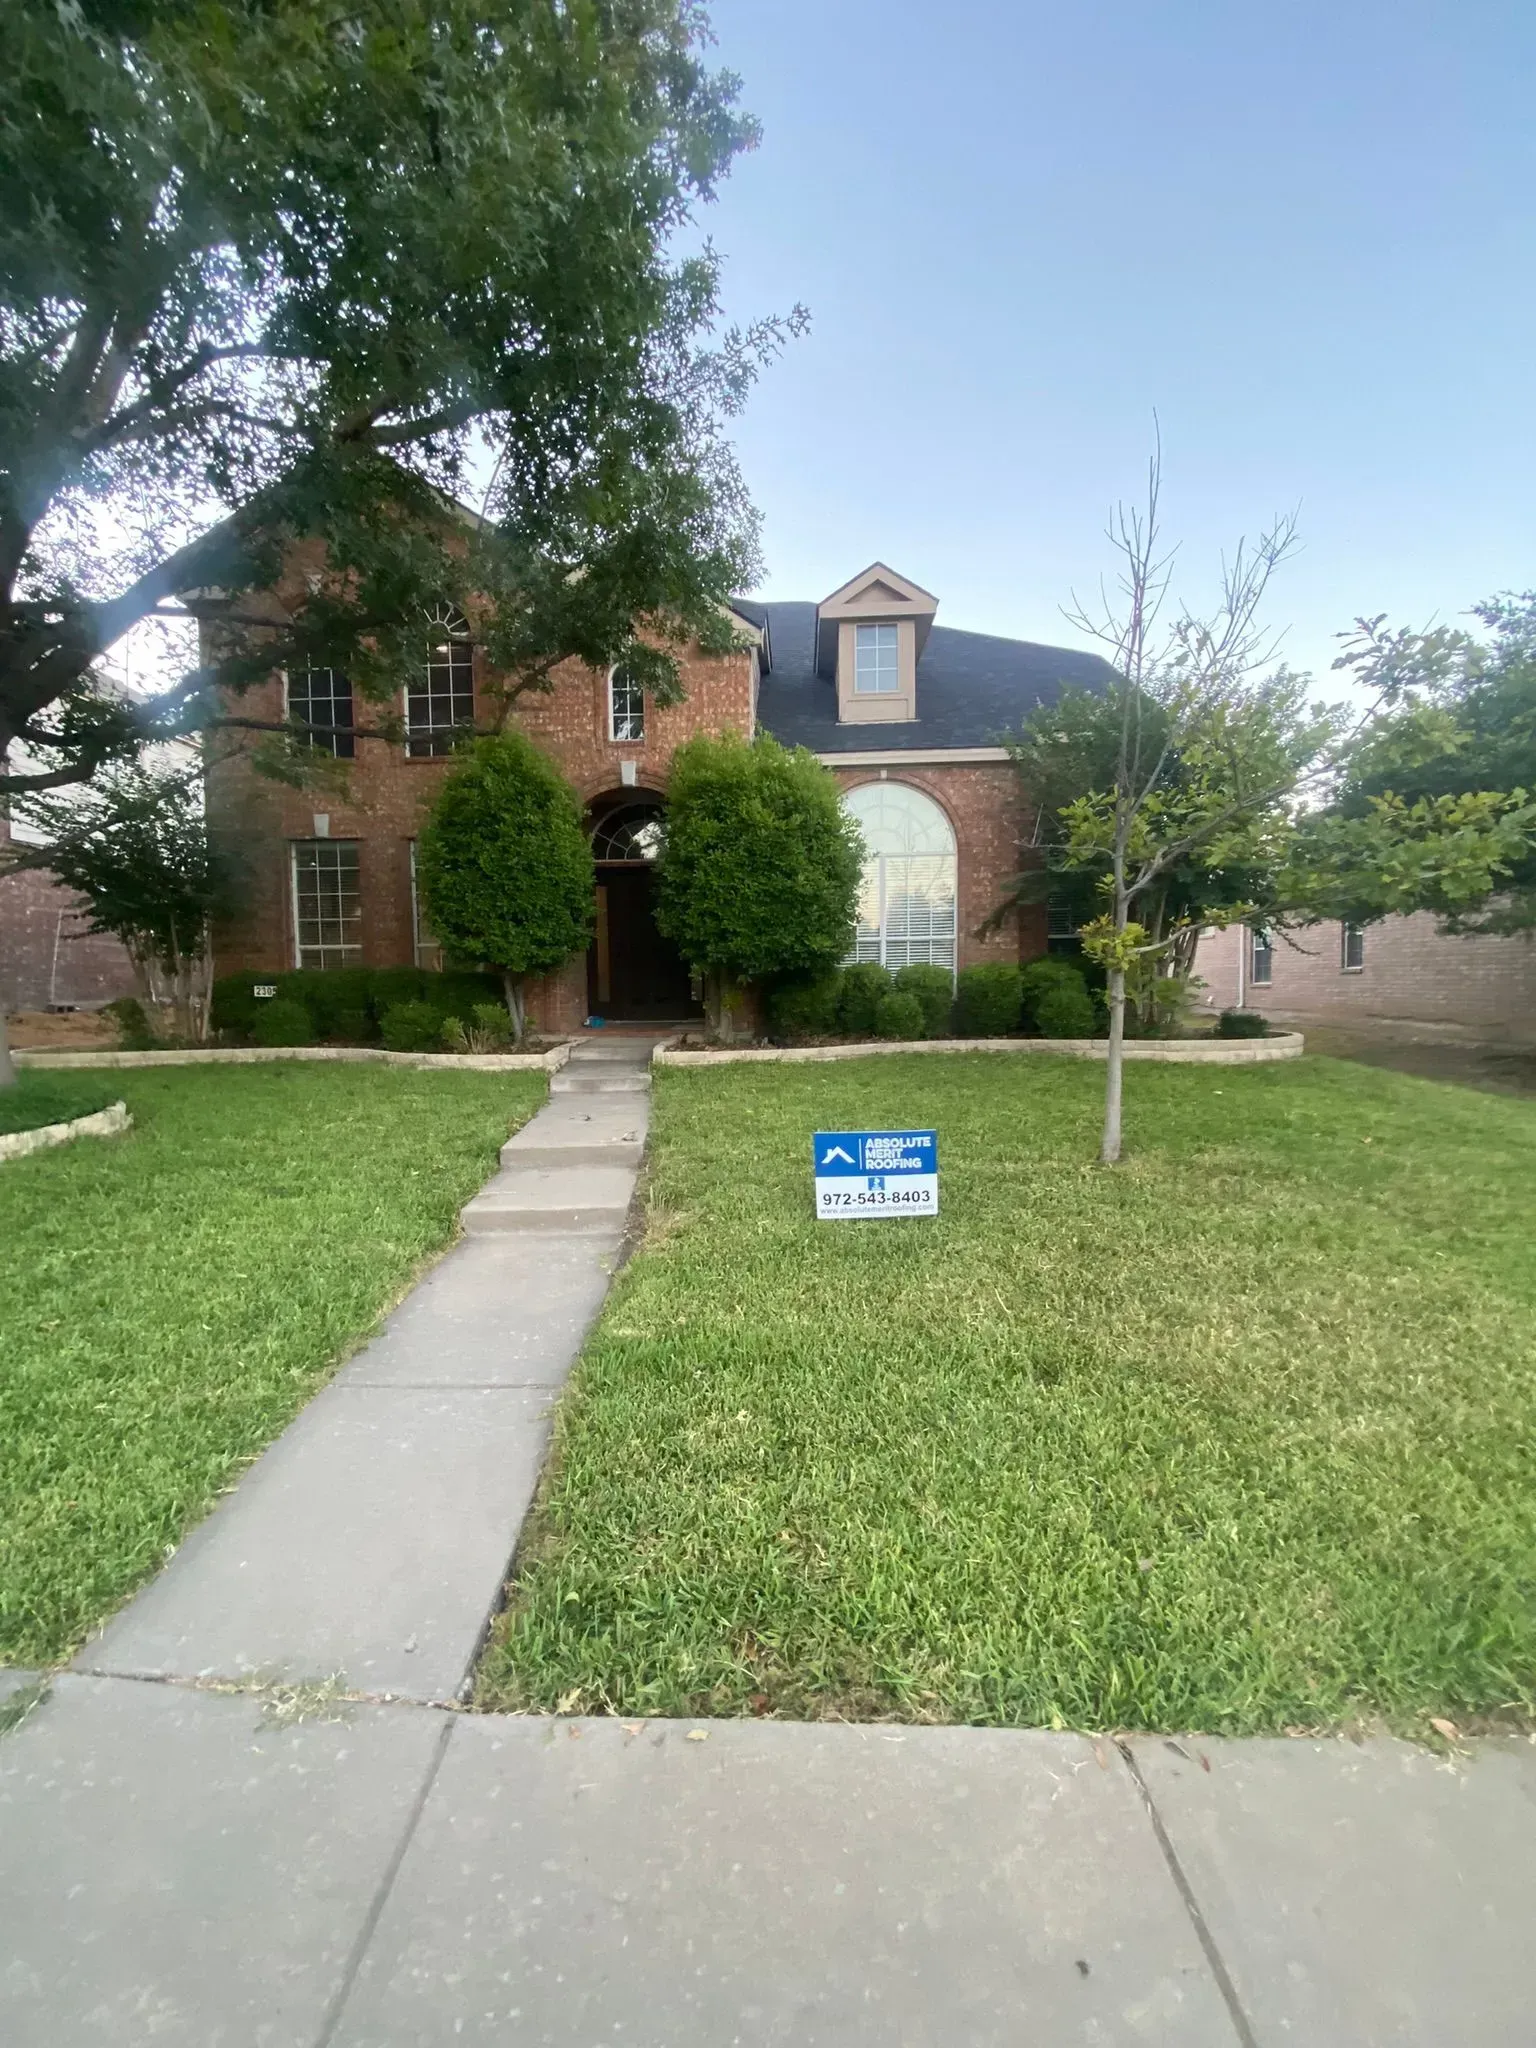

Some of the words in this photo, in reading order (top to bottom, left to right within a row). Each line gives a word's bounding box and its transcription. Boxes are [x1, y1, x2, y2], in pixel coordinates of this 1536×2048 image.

[865, 1136, 931, 1149] ABSOLUTE
[865, 1148, 903, 1159] MERIT
[866, 1158, 922, 1170] ROOFING
[823, 1190, 930, 1206] 972-543-8403
[821, 1204, 934, 1215] www.absolutemeritroofing.com
